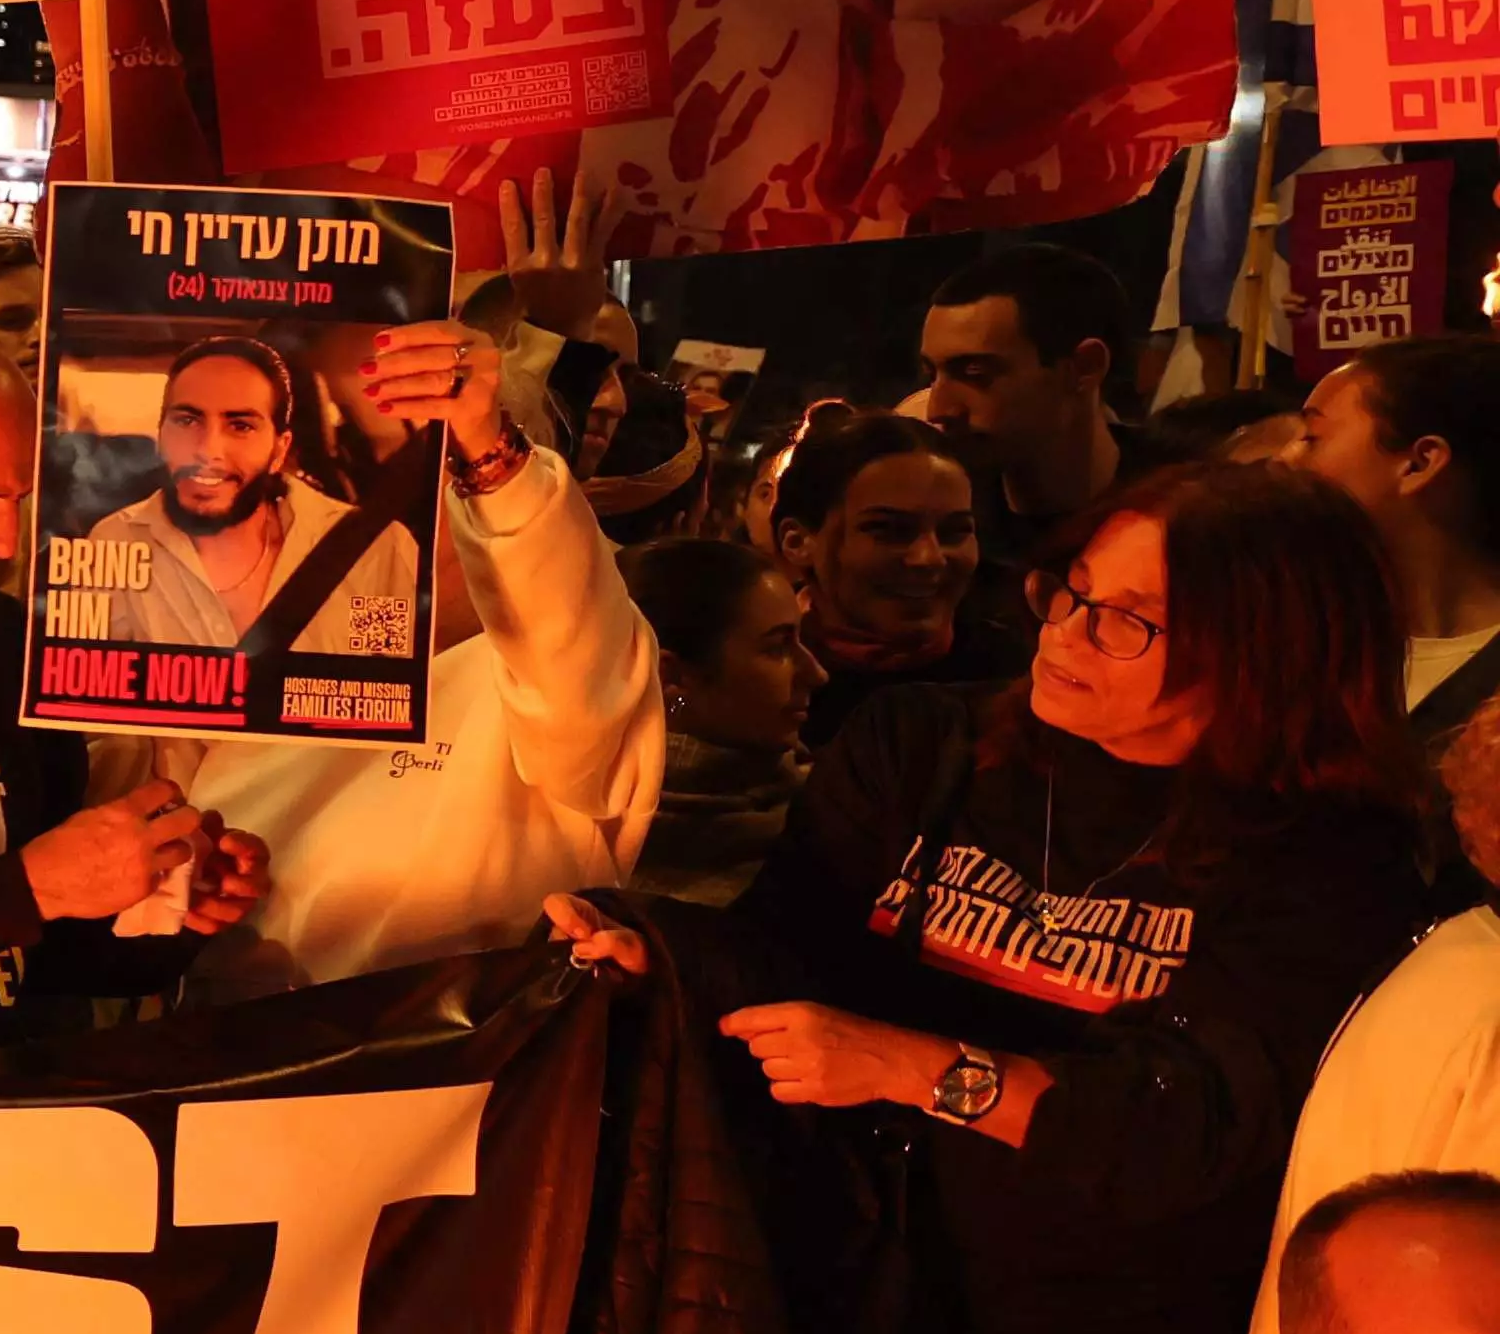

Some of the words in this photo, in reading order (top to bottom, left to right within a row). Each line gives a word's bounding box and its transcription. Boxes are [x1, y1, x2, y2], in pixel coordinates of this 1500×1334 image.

[126, 209, 173, 256] חי
[184, 212, 287, 267] עדיין
[297, 218, 381, 272] מתן
[167, 270, 205, 302] (24)
[293, 280, 333, 308] מתן
[1325, 314, 1405, 342] חיים
[46, 535, 153, 592] BRING
[45, 589, 113, 642] HIM
[40, 646, 141, 701] HOME
[145, 650, 250, 708] NOW!
[283, 676, 339, 696] HOSTAGES
[339, 681, 362, 698] AND
[362, 682, 412, 701] MISSING
[282, 693, 352, 721] FAMILIES
[354, 698, 412, 725] FORUM
